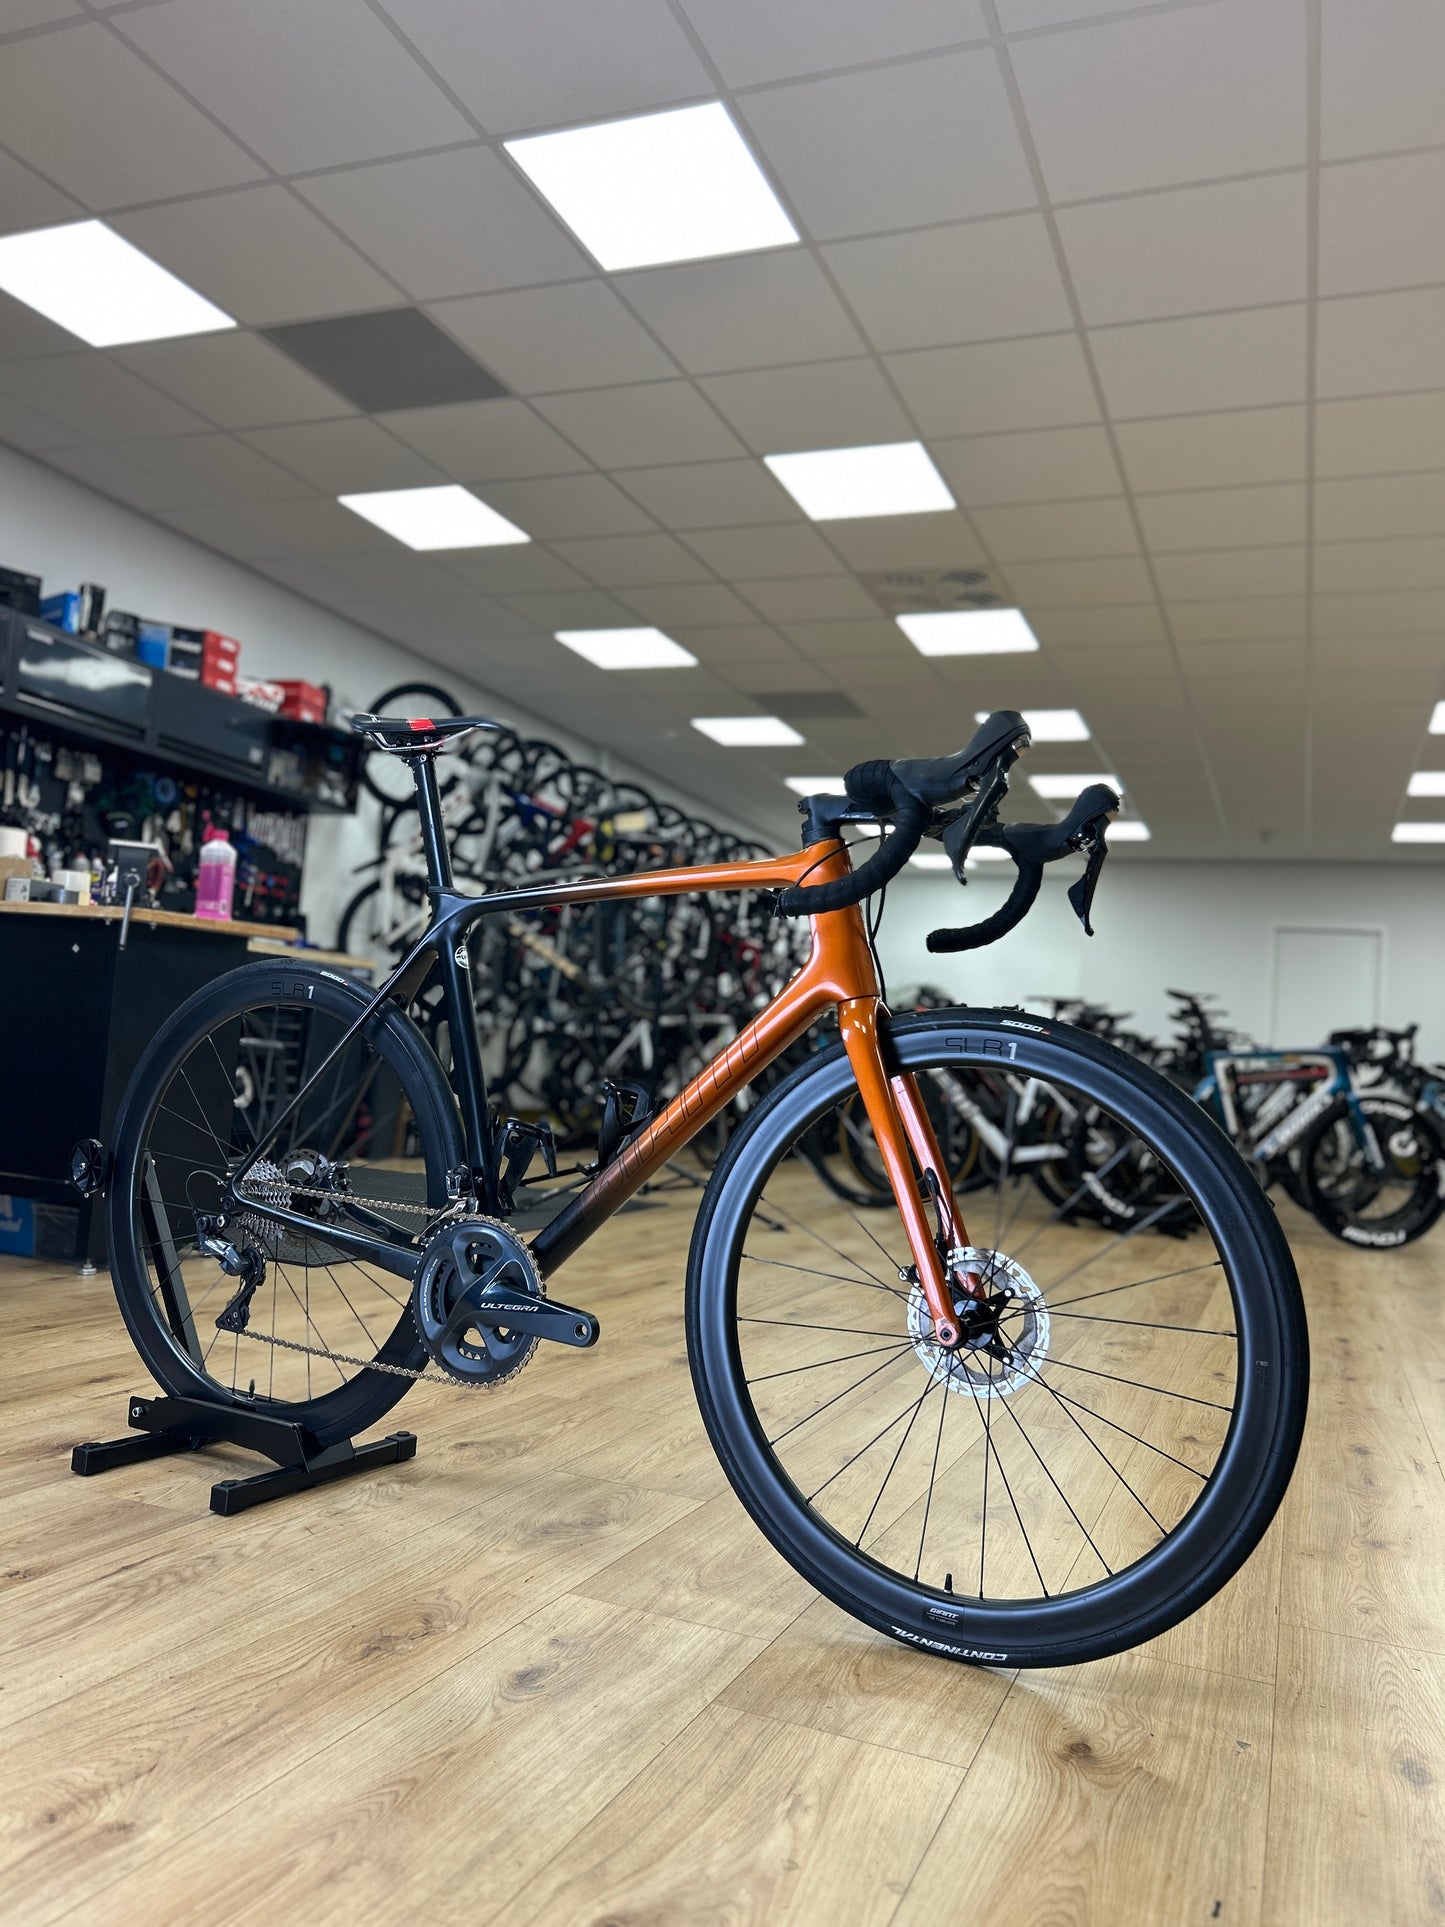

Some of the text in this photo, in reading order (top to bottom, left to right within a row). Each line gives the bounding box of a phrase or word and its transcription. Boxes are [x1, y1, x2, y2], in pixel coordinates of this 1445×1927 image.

[480, 1302, 540, 1312] ULTEGRA
[929, 1607, 960, 1619] GIANT
[890, 1625, 1008, 1662] CONTINENTAL
